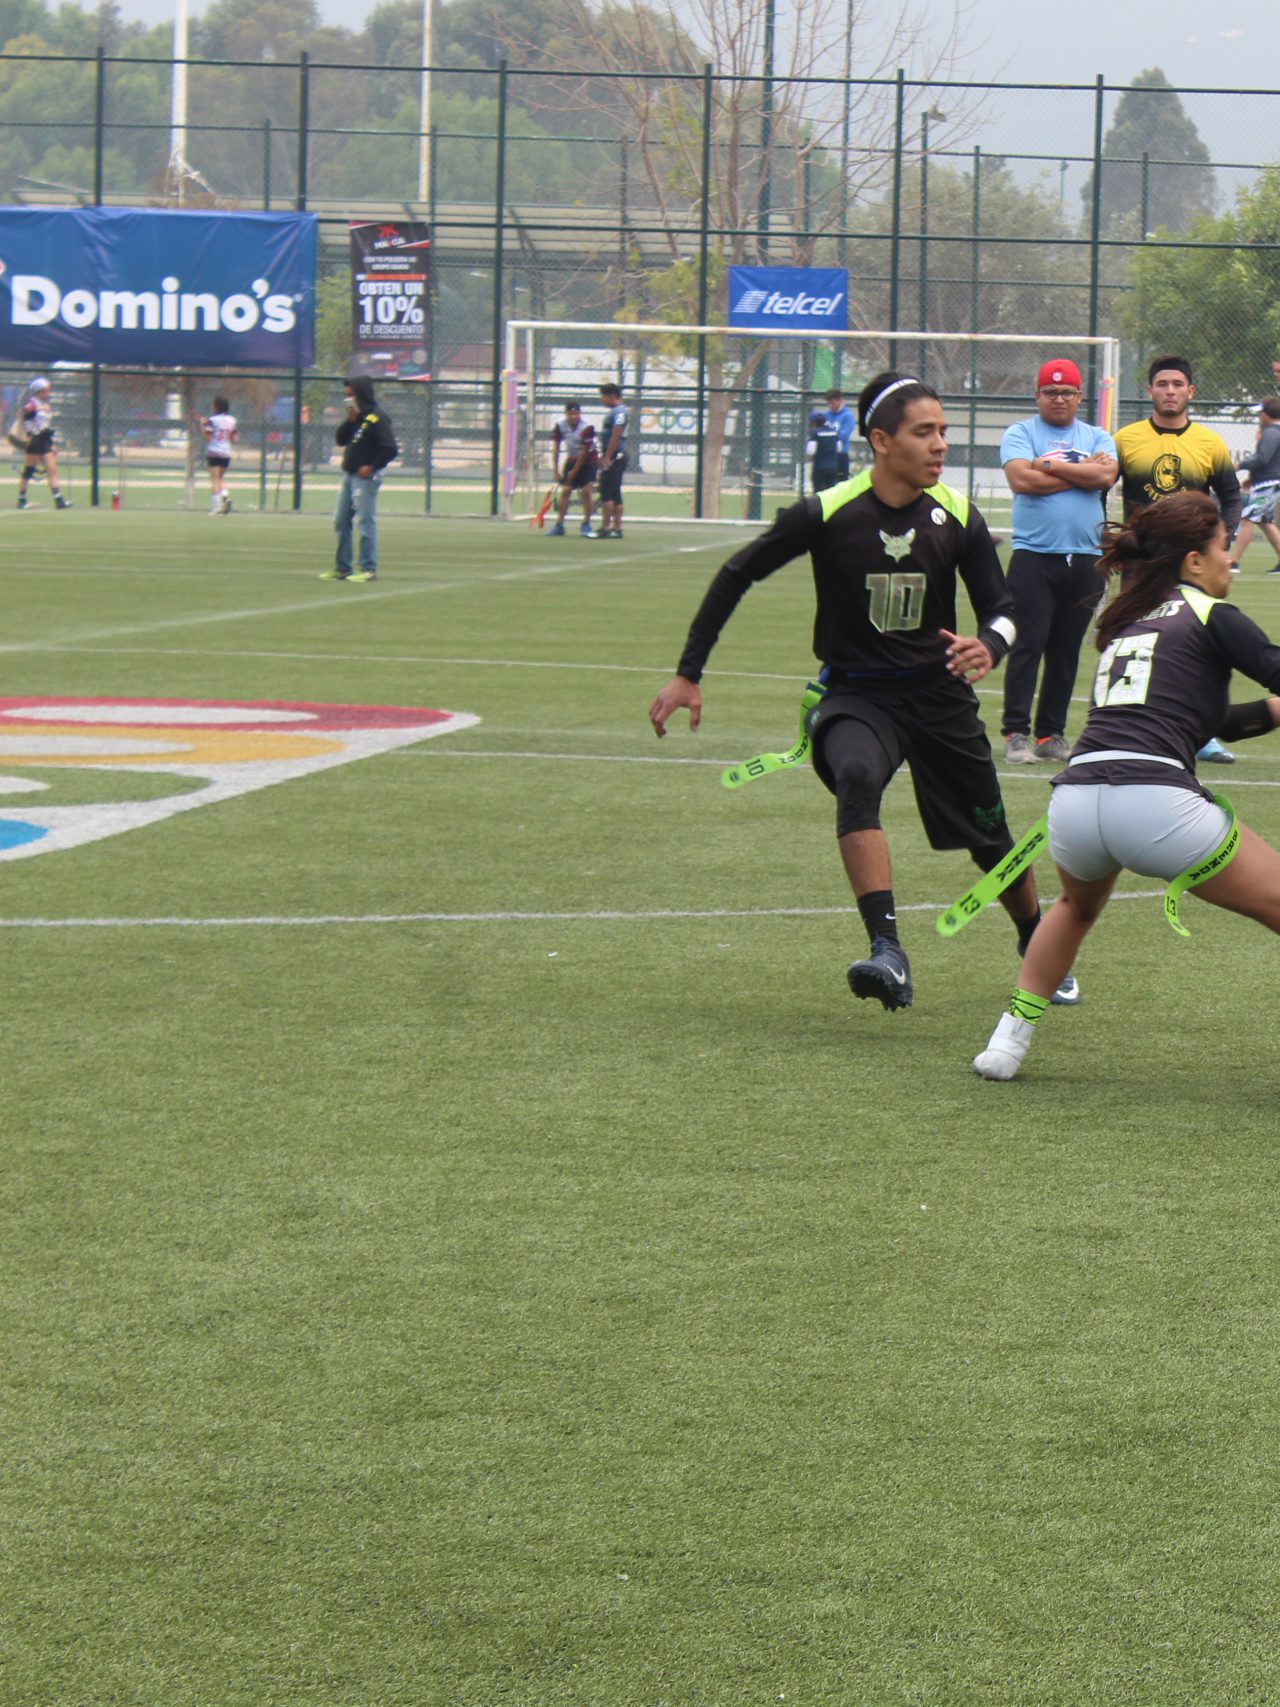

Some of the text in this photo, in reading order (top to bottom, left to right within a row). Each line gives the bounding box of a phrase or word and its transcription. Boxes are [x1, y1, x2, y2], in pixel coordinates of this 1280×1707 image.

[404, 282, 424, 296] UN
[11, 275, 297, 333] Domino's
[359, 296, 425, 324] 10%
[762, 291, 843, 316] telcel
[360, 325, 424, 335] DE DESCUENTO
[865, 572, 927, 634] 10
[1094, 632, 1160, 708] 13
[745, 758, 765, 777] 10
